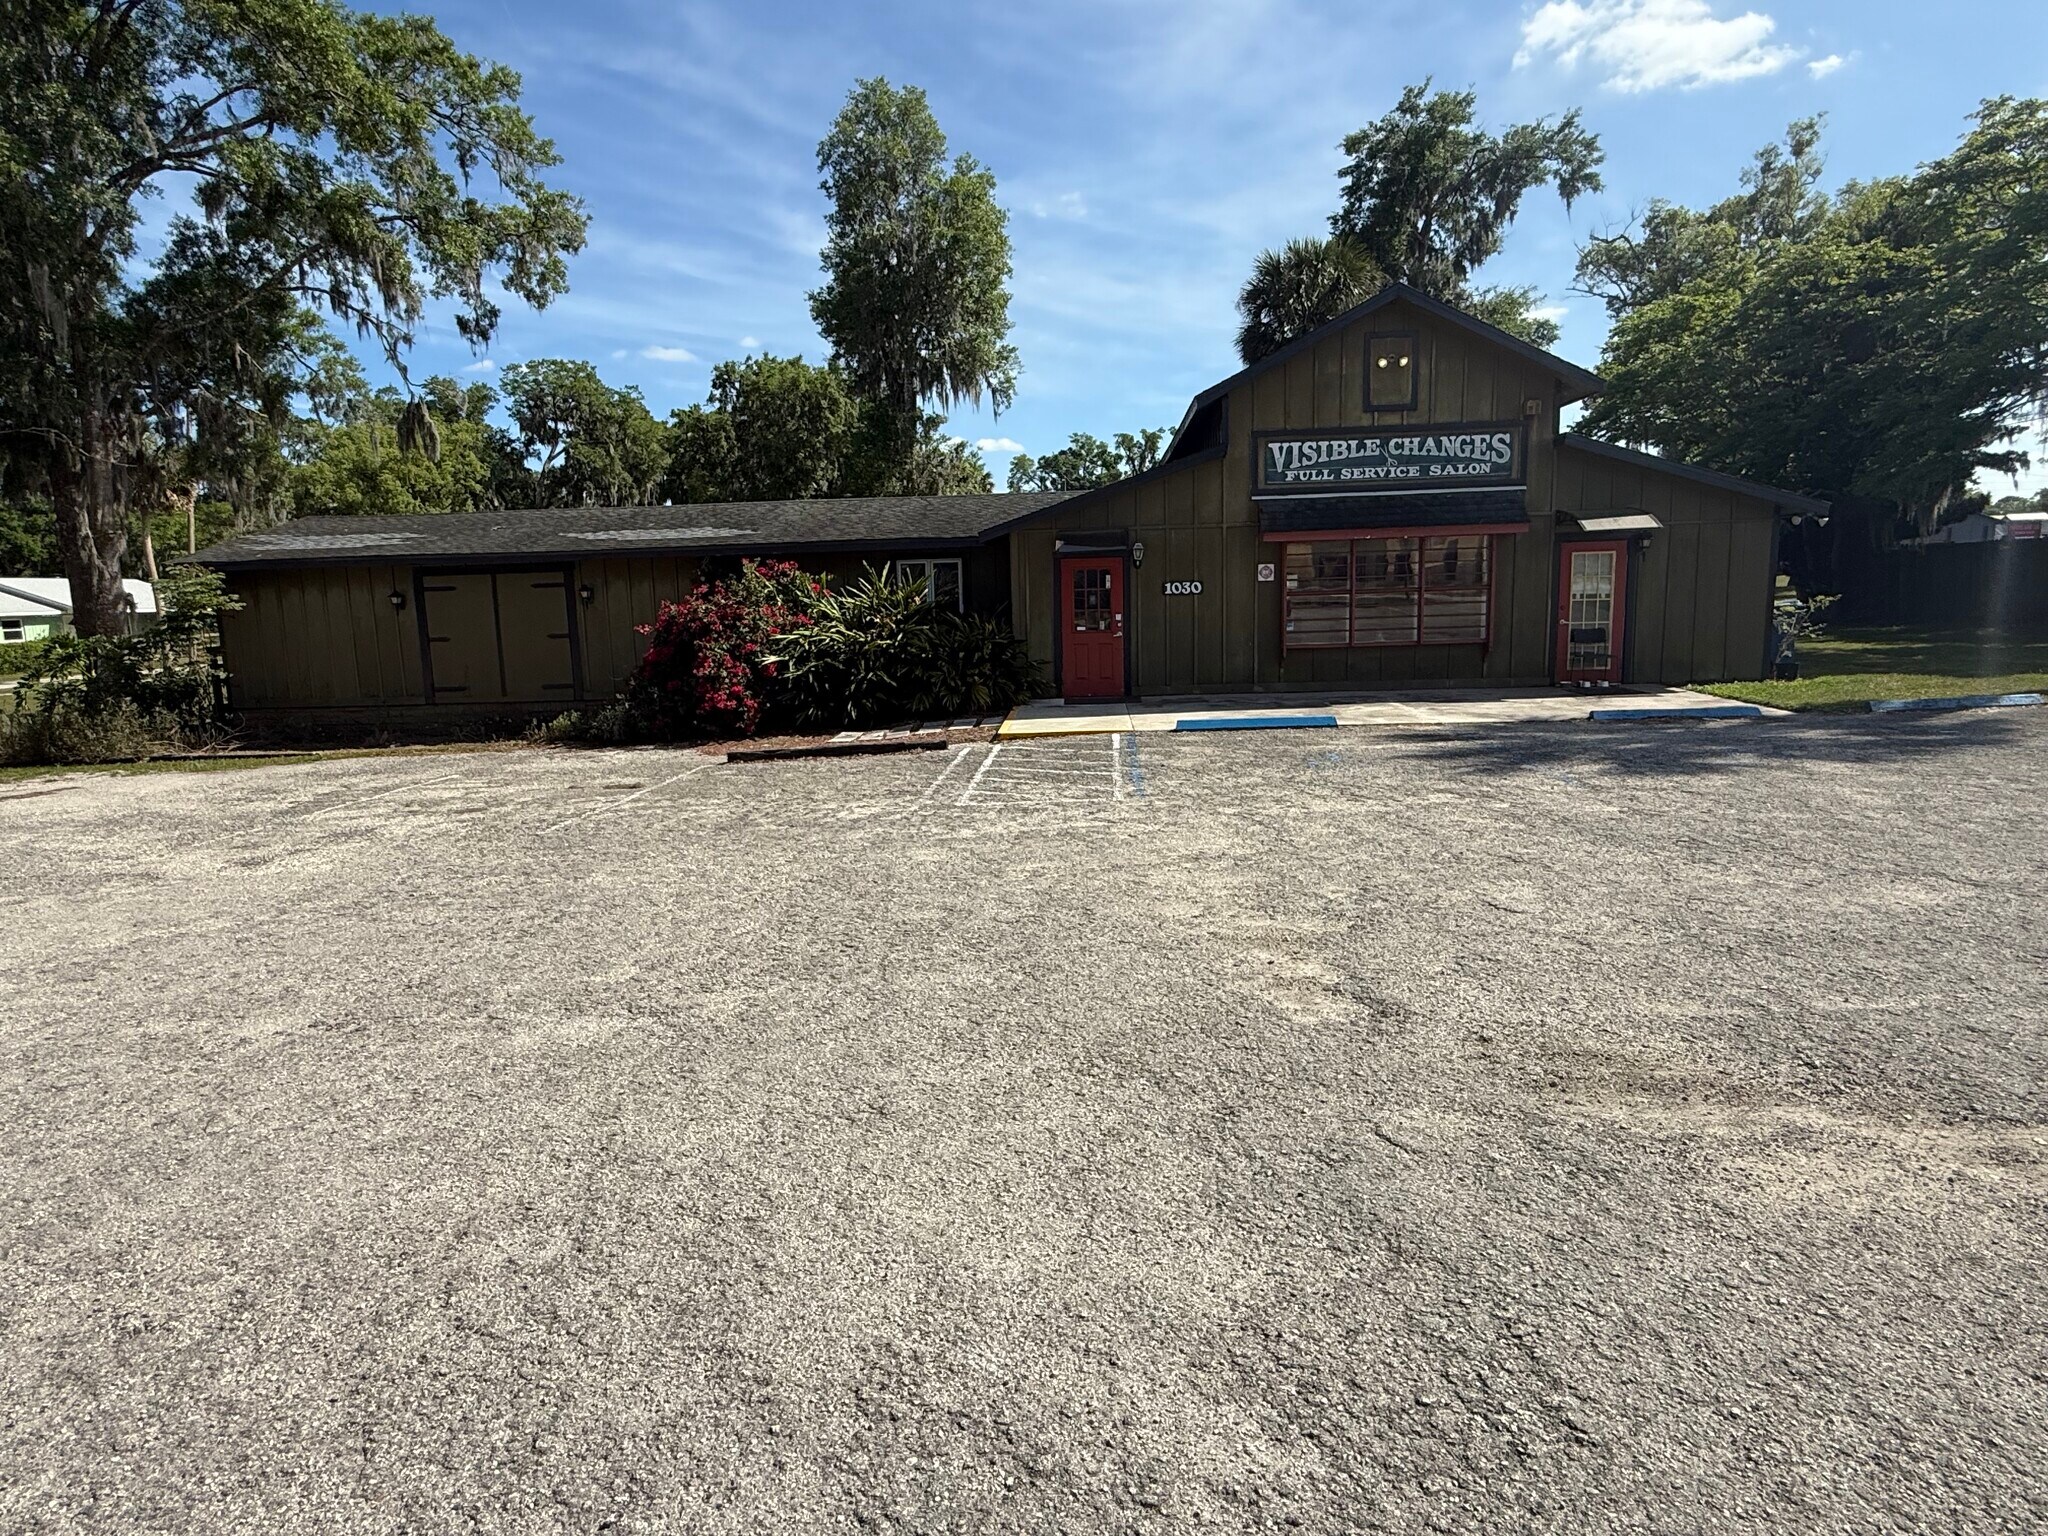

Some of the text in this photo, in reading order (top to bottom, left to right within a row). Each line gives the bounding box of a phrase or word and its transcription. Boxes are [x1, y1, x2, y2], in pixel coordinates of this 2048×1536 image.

[1268, 433, 1511, 472] VISIBLE CHANGES
[1285, 462, 1492, 481] FULL SERVICE SALON
[1164, 582, 1202, 594] 1030
